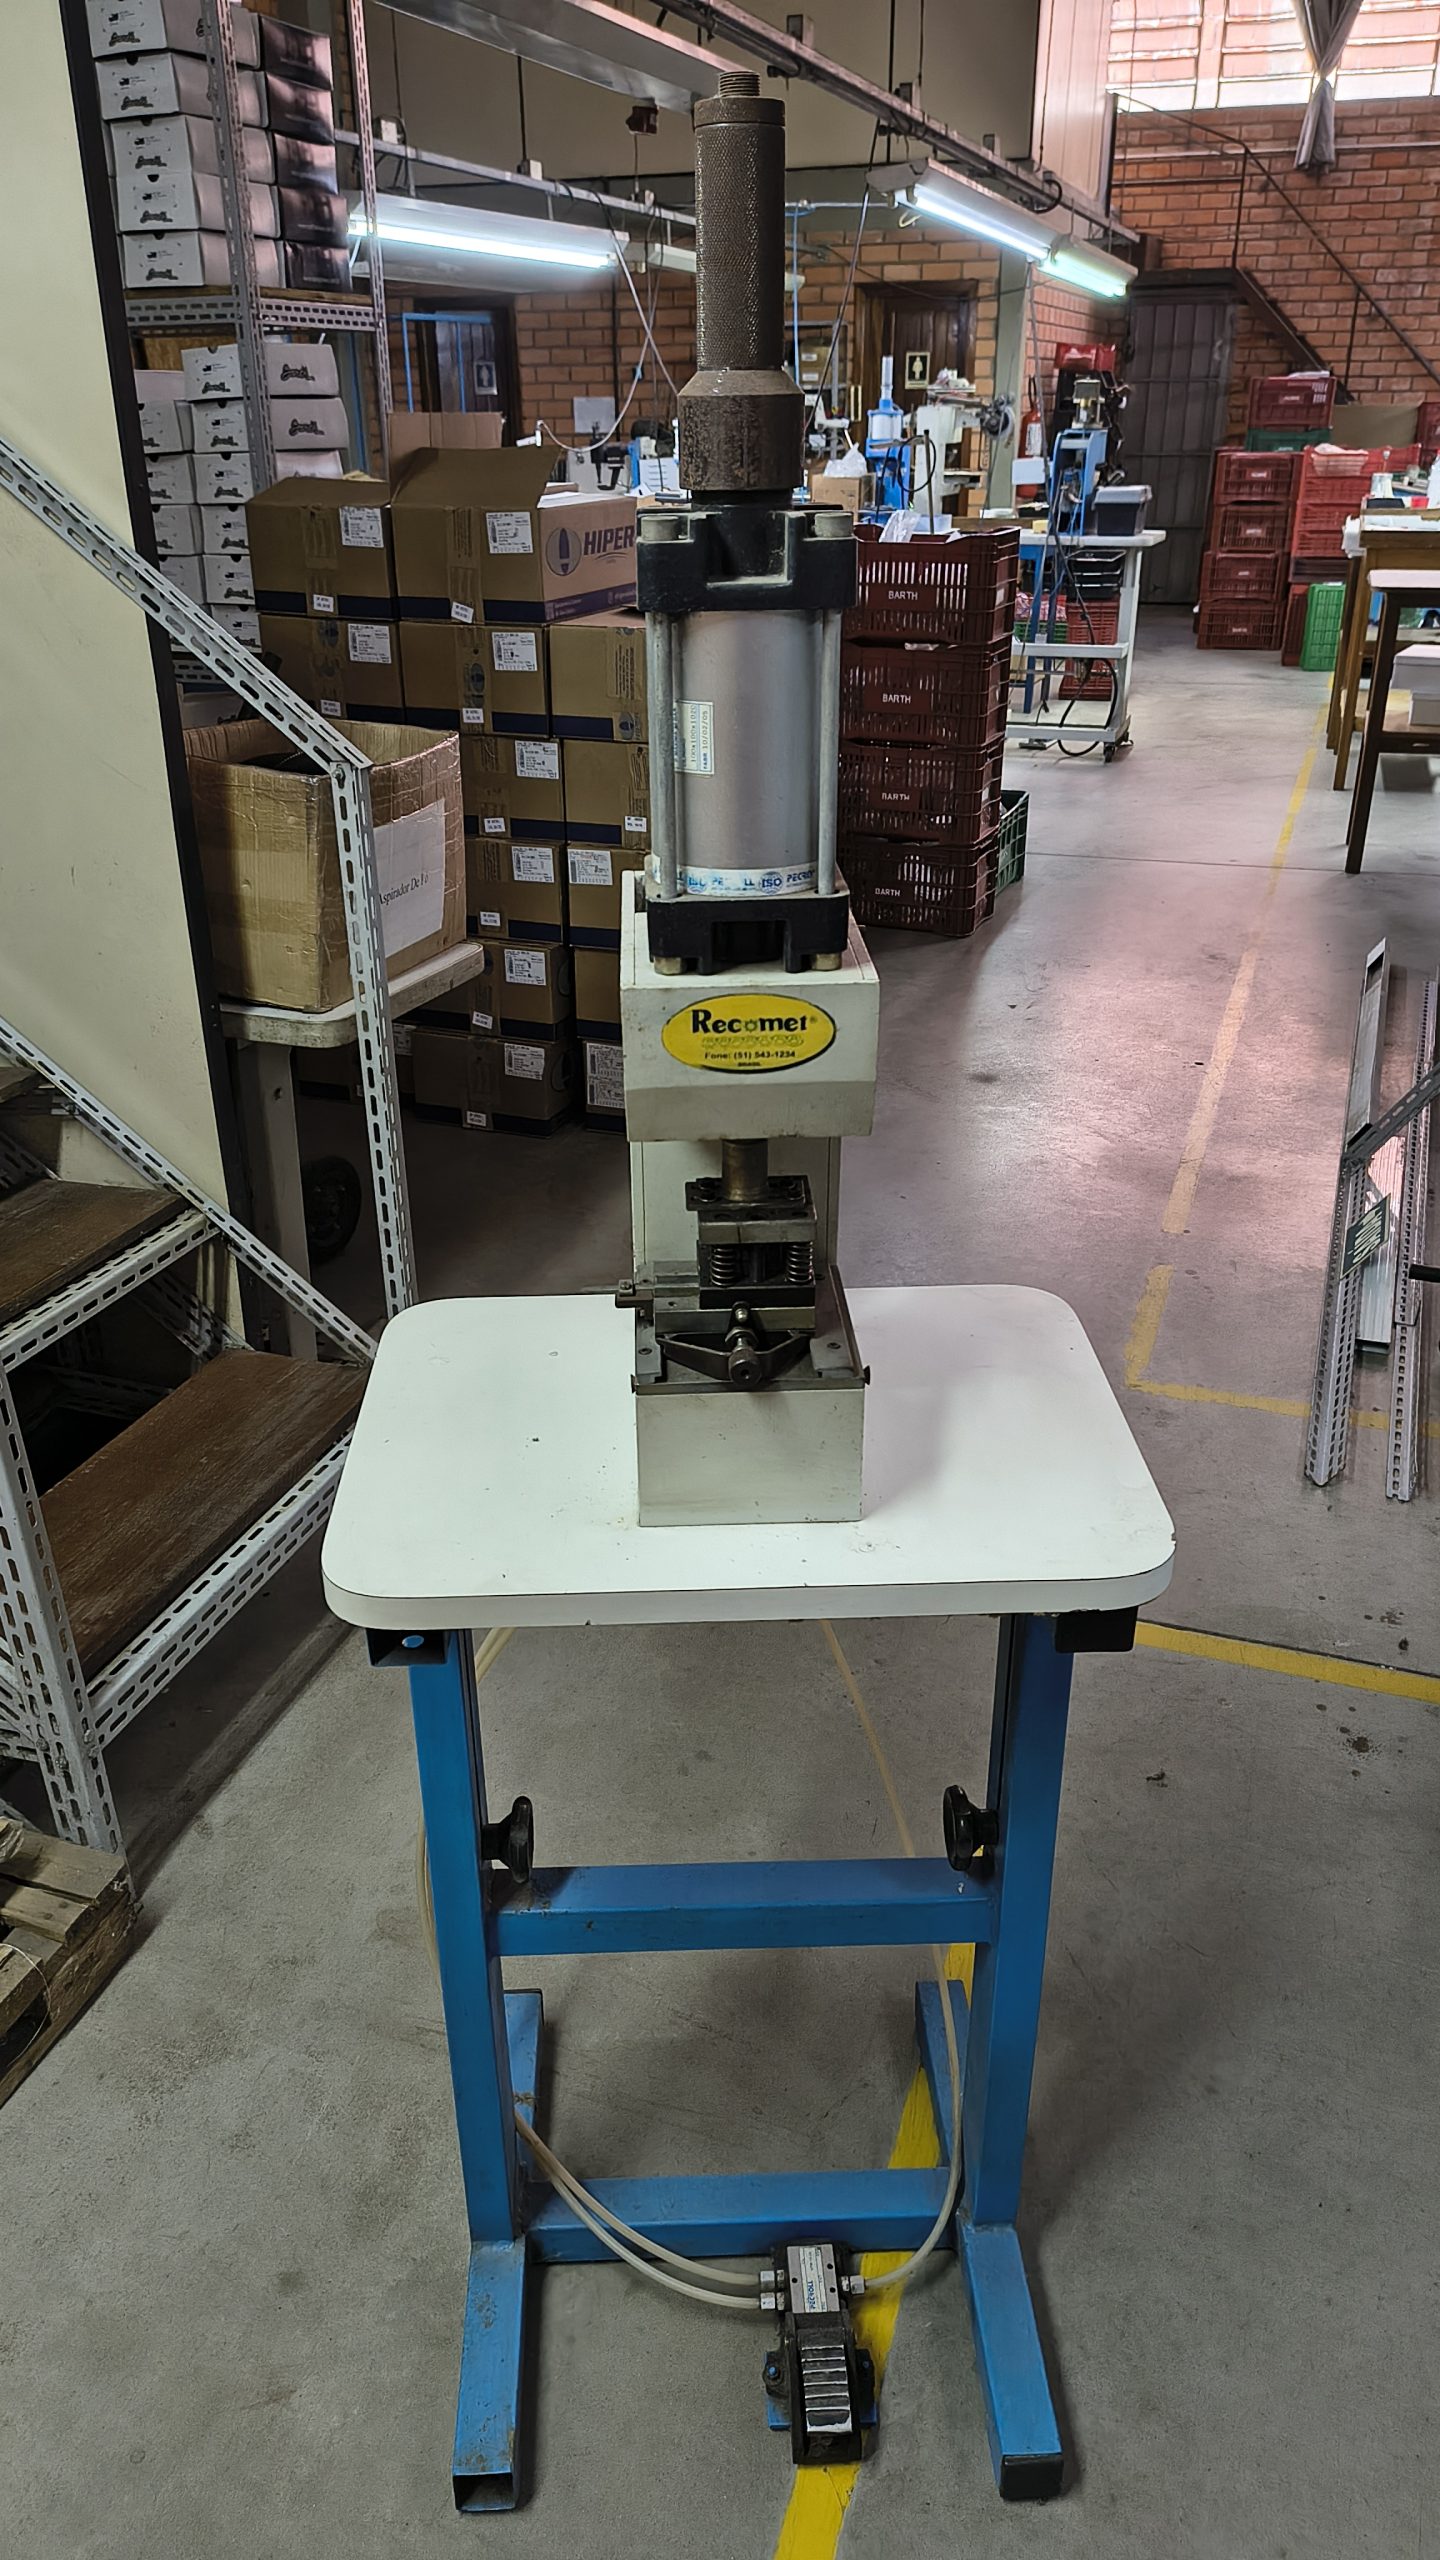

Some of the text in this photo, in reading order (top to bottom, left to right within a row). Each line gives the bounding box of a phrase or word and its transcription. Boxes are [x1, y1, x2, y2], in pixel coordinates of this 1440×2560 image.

[583, 525, 635, 555] HIPER
[888, 590, 918, 600] BARTH
[882, 693, 911, 704] BARTH
[761, 877, 782, 887] ISO
[692, 1008, 807, 1034] Recomet
[705, 1050, 796, 1060] Fone: (51) 543-1234
